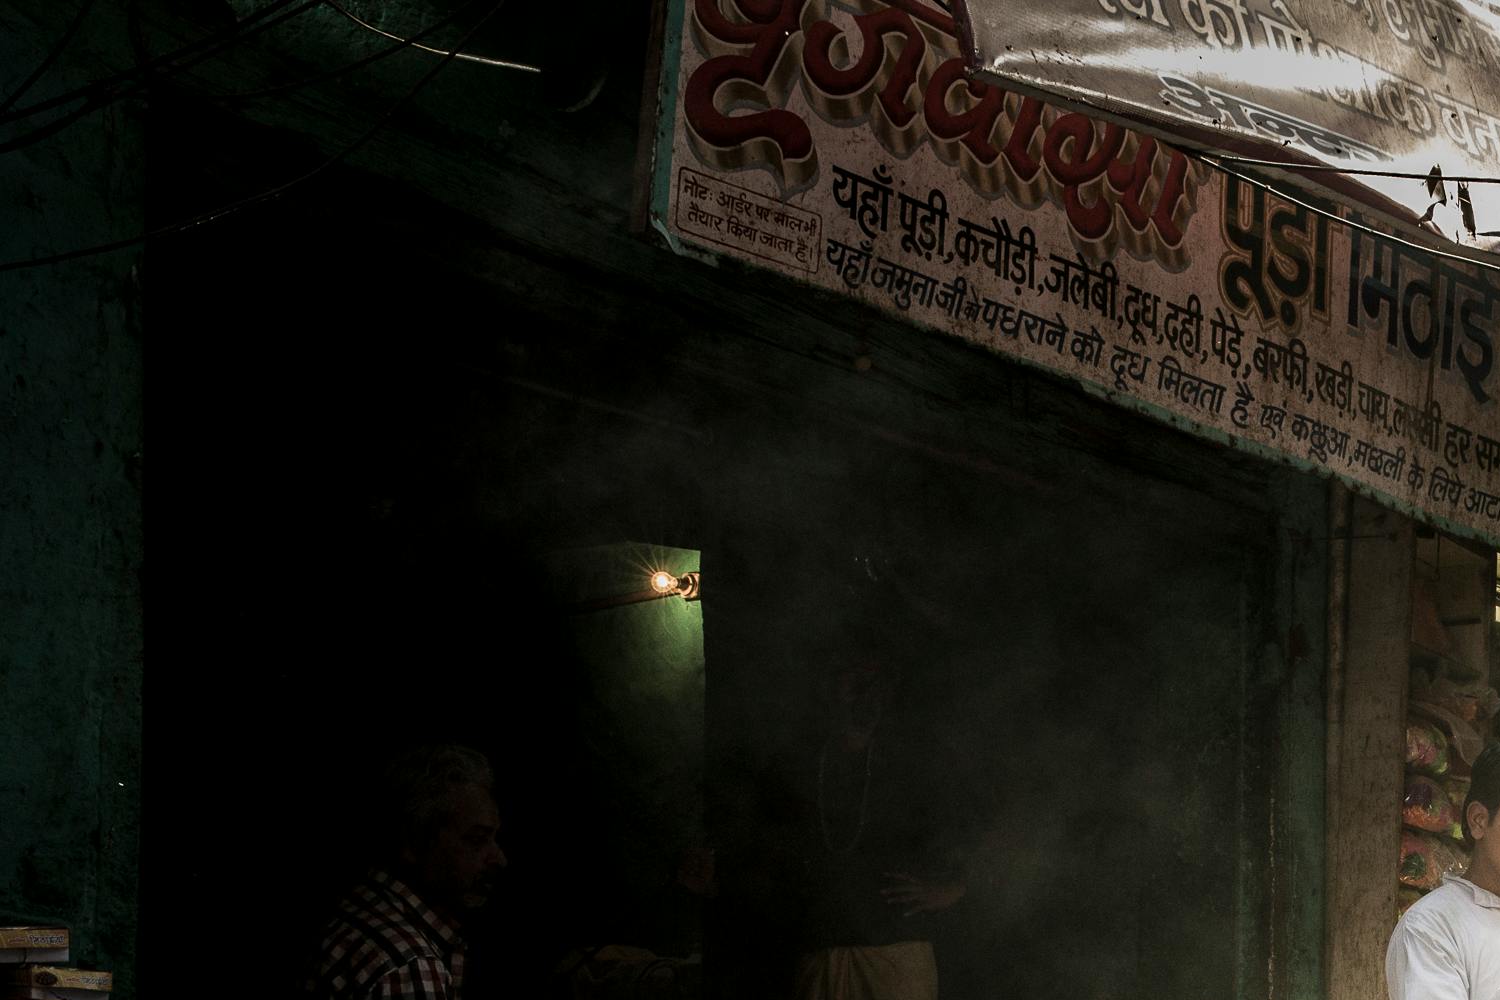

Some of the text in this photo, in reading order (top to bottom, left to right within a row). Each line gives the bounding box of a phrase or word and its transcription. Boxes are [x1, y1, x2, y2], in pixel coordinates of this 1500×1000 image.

[687, 203, 724, 230] तैयार
[727, 217, 757, 242] किया
[759, 231, 794, 253] जाता
[716, 191, 755, 217] आर्डर
[756, 206, 771, 223] पर
[773, 211, 802, 231] माल
[802, 217, 817, 236] भी
[827, 239, 873, 289] यहाँ
[983, 297, 1069, 354] पधराने
[1070, 326, 1106, 369] को
[1110, 345, 1152, 391] दूध
[1157, 355, 1227, 414] मिलता
[1231, 381, 1255, 428] है
[1261, 400, 1287, 439] एवं
[1354, 440, 1406, 482] मछली
[1408, 455, 1425, 491] के
[1428, 466, 1466, 507] लिये
[832, 164, 894, 239] यहाँ
[1444, 422, 1473, 468] हर
